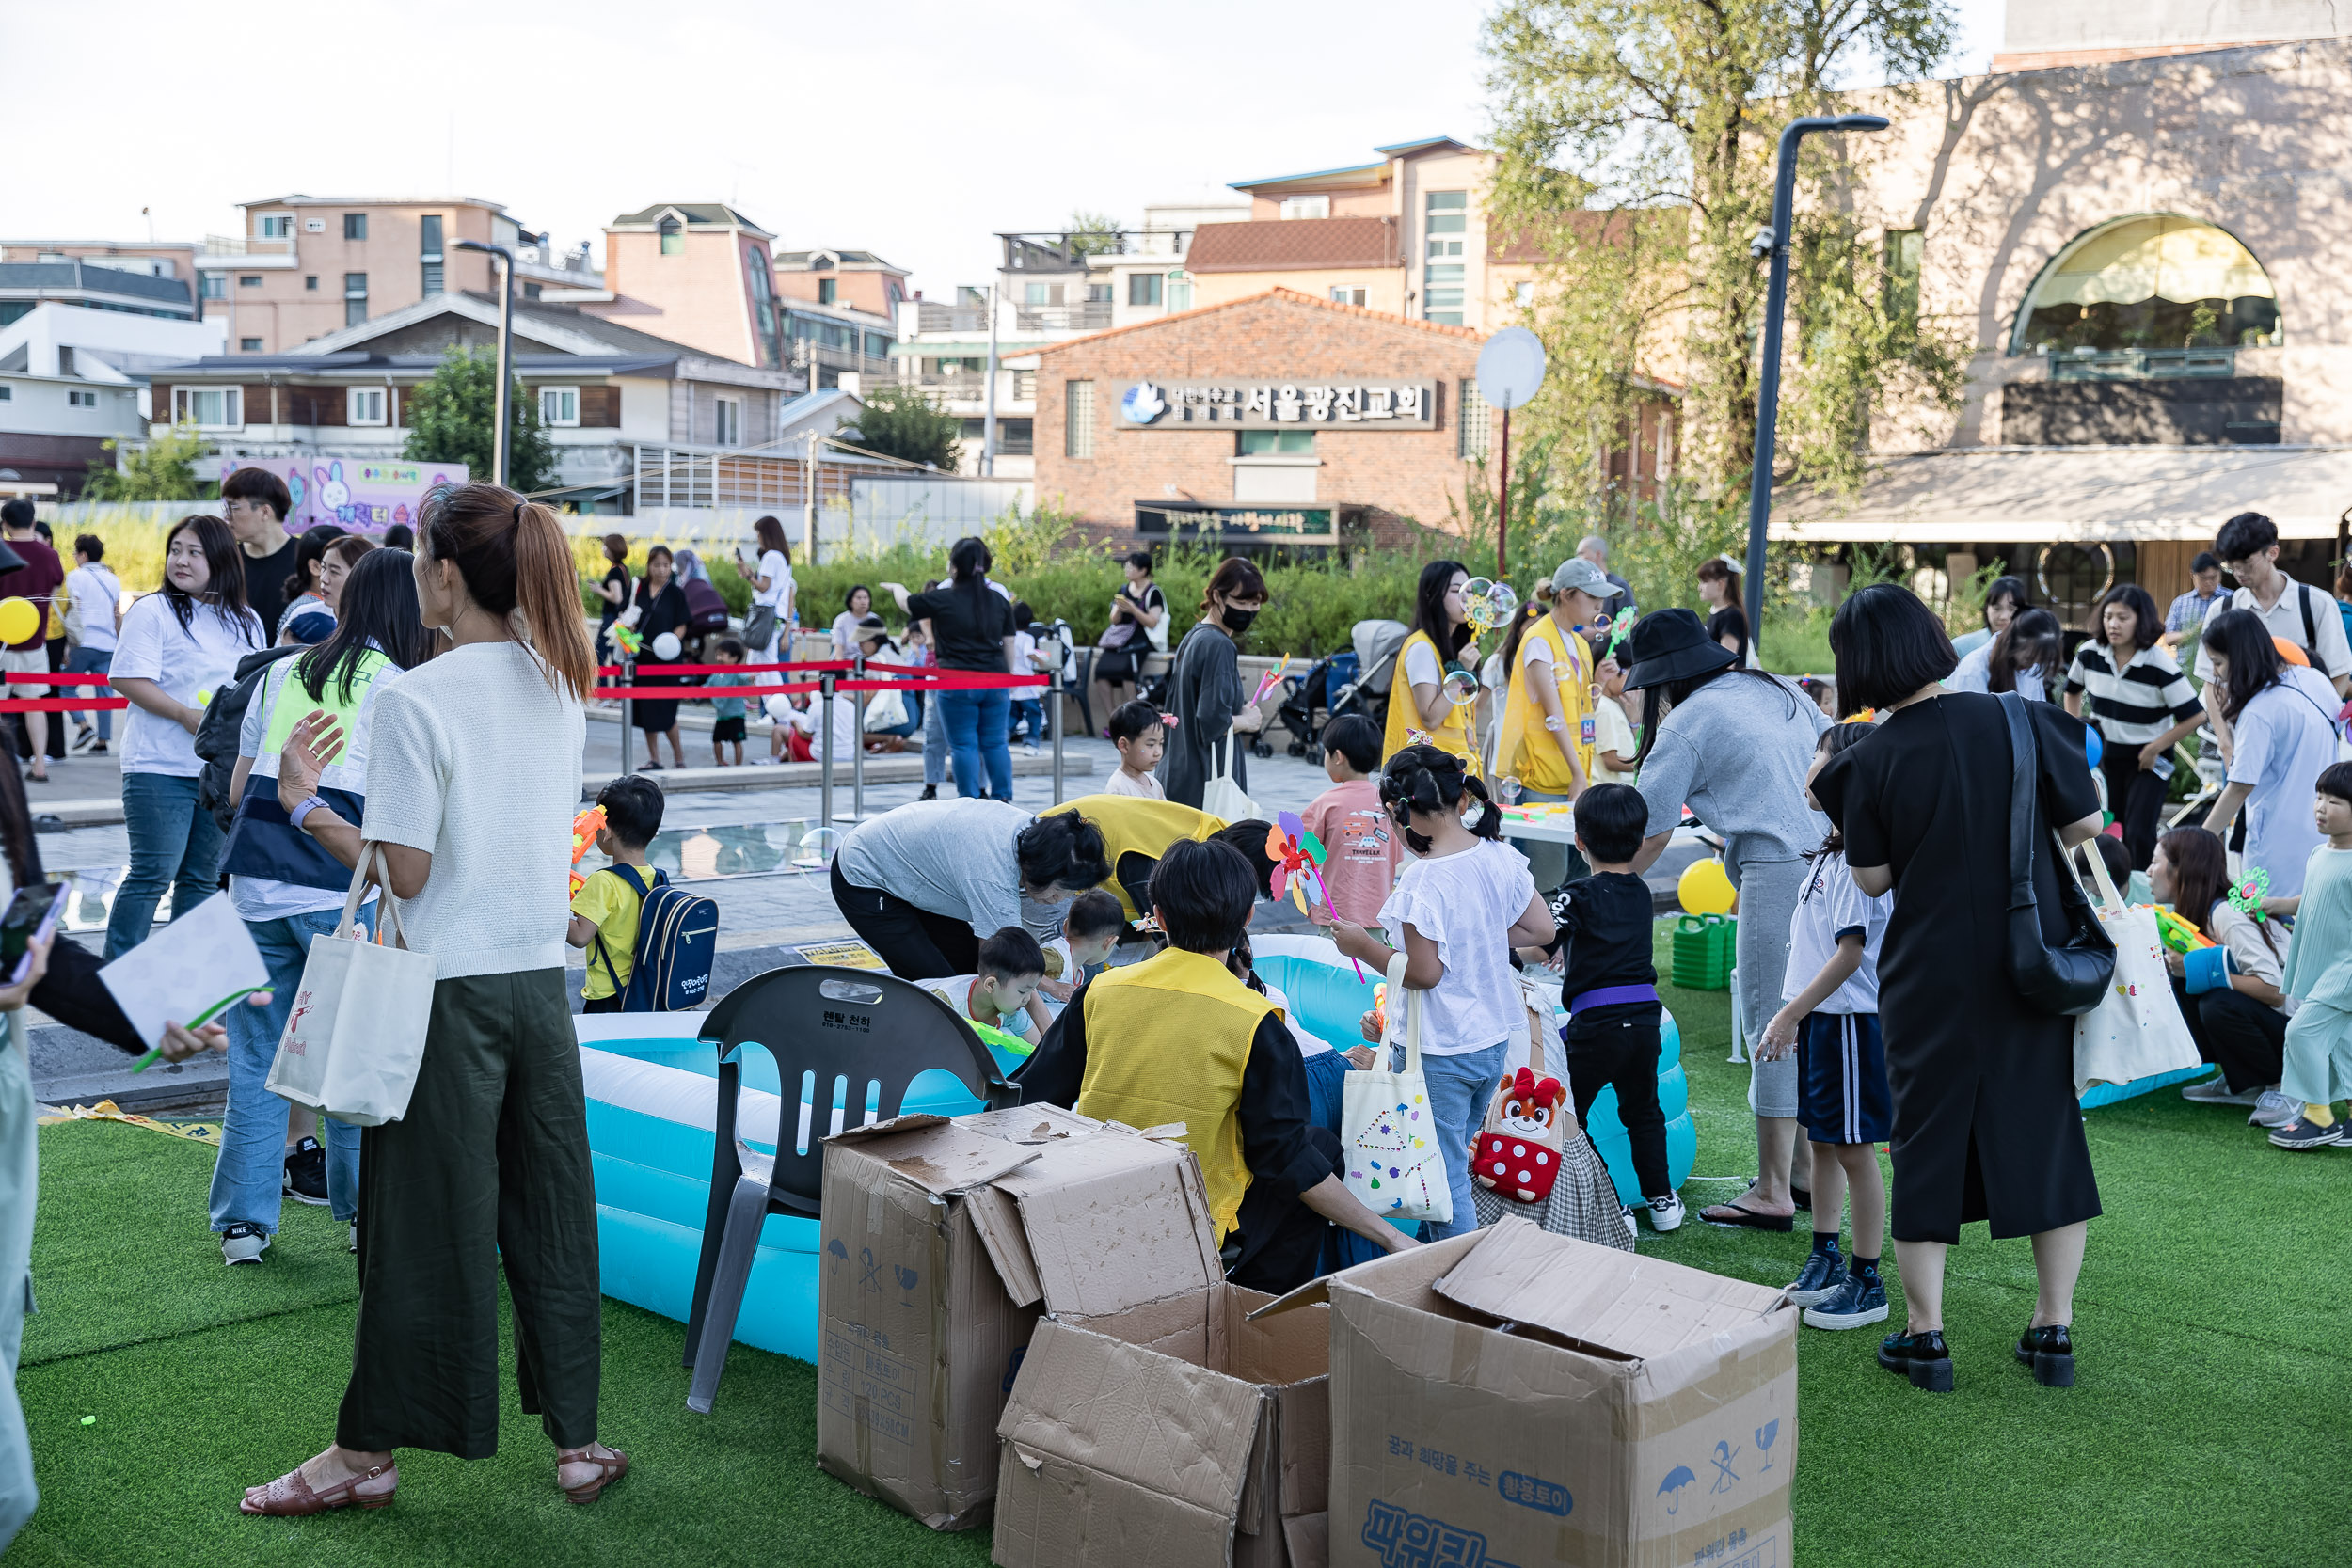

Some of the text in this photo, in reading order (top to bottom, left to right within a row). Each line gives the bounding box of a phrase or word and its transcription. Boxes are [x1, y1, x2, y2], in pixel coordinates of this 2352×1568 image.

[1245, 384, 1423, 422] 서울광진교회
[336, 503, 389, 528] 캐릭터
[823, 1010, 871, 1027] 렌탈 천하
[827, 1337, 900, 1385] 수입원 황용토이
[860, 1380, 878, 1400] 120
[881, 1387, 901, 1410] PCS
[1388, 1434, 1567, 1513] 꿈과 희망을 주는 황용토이
